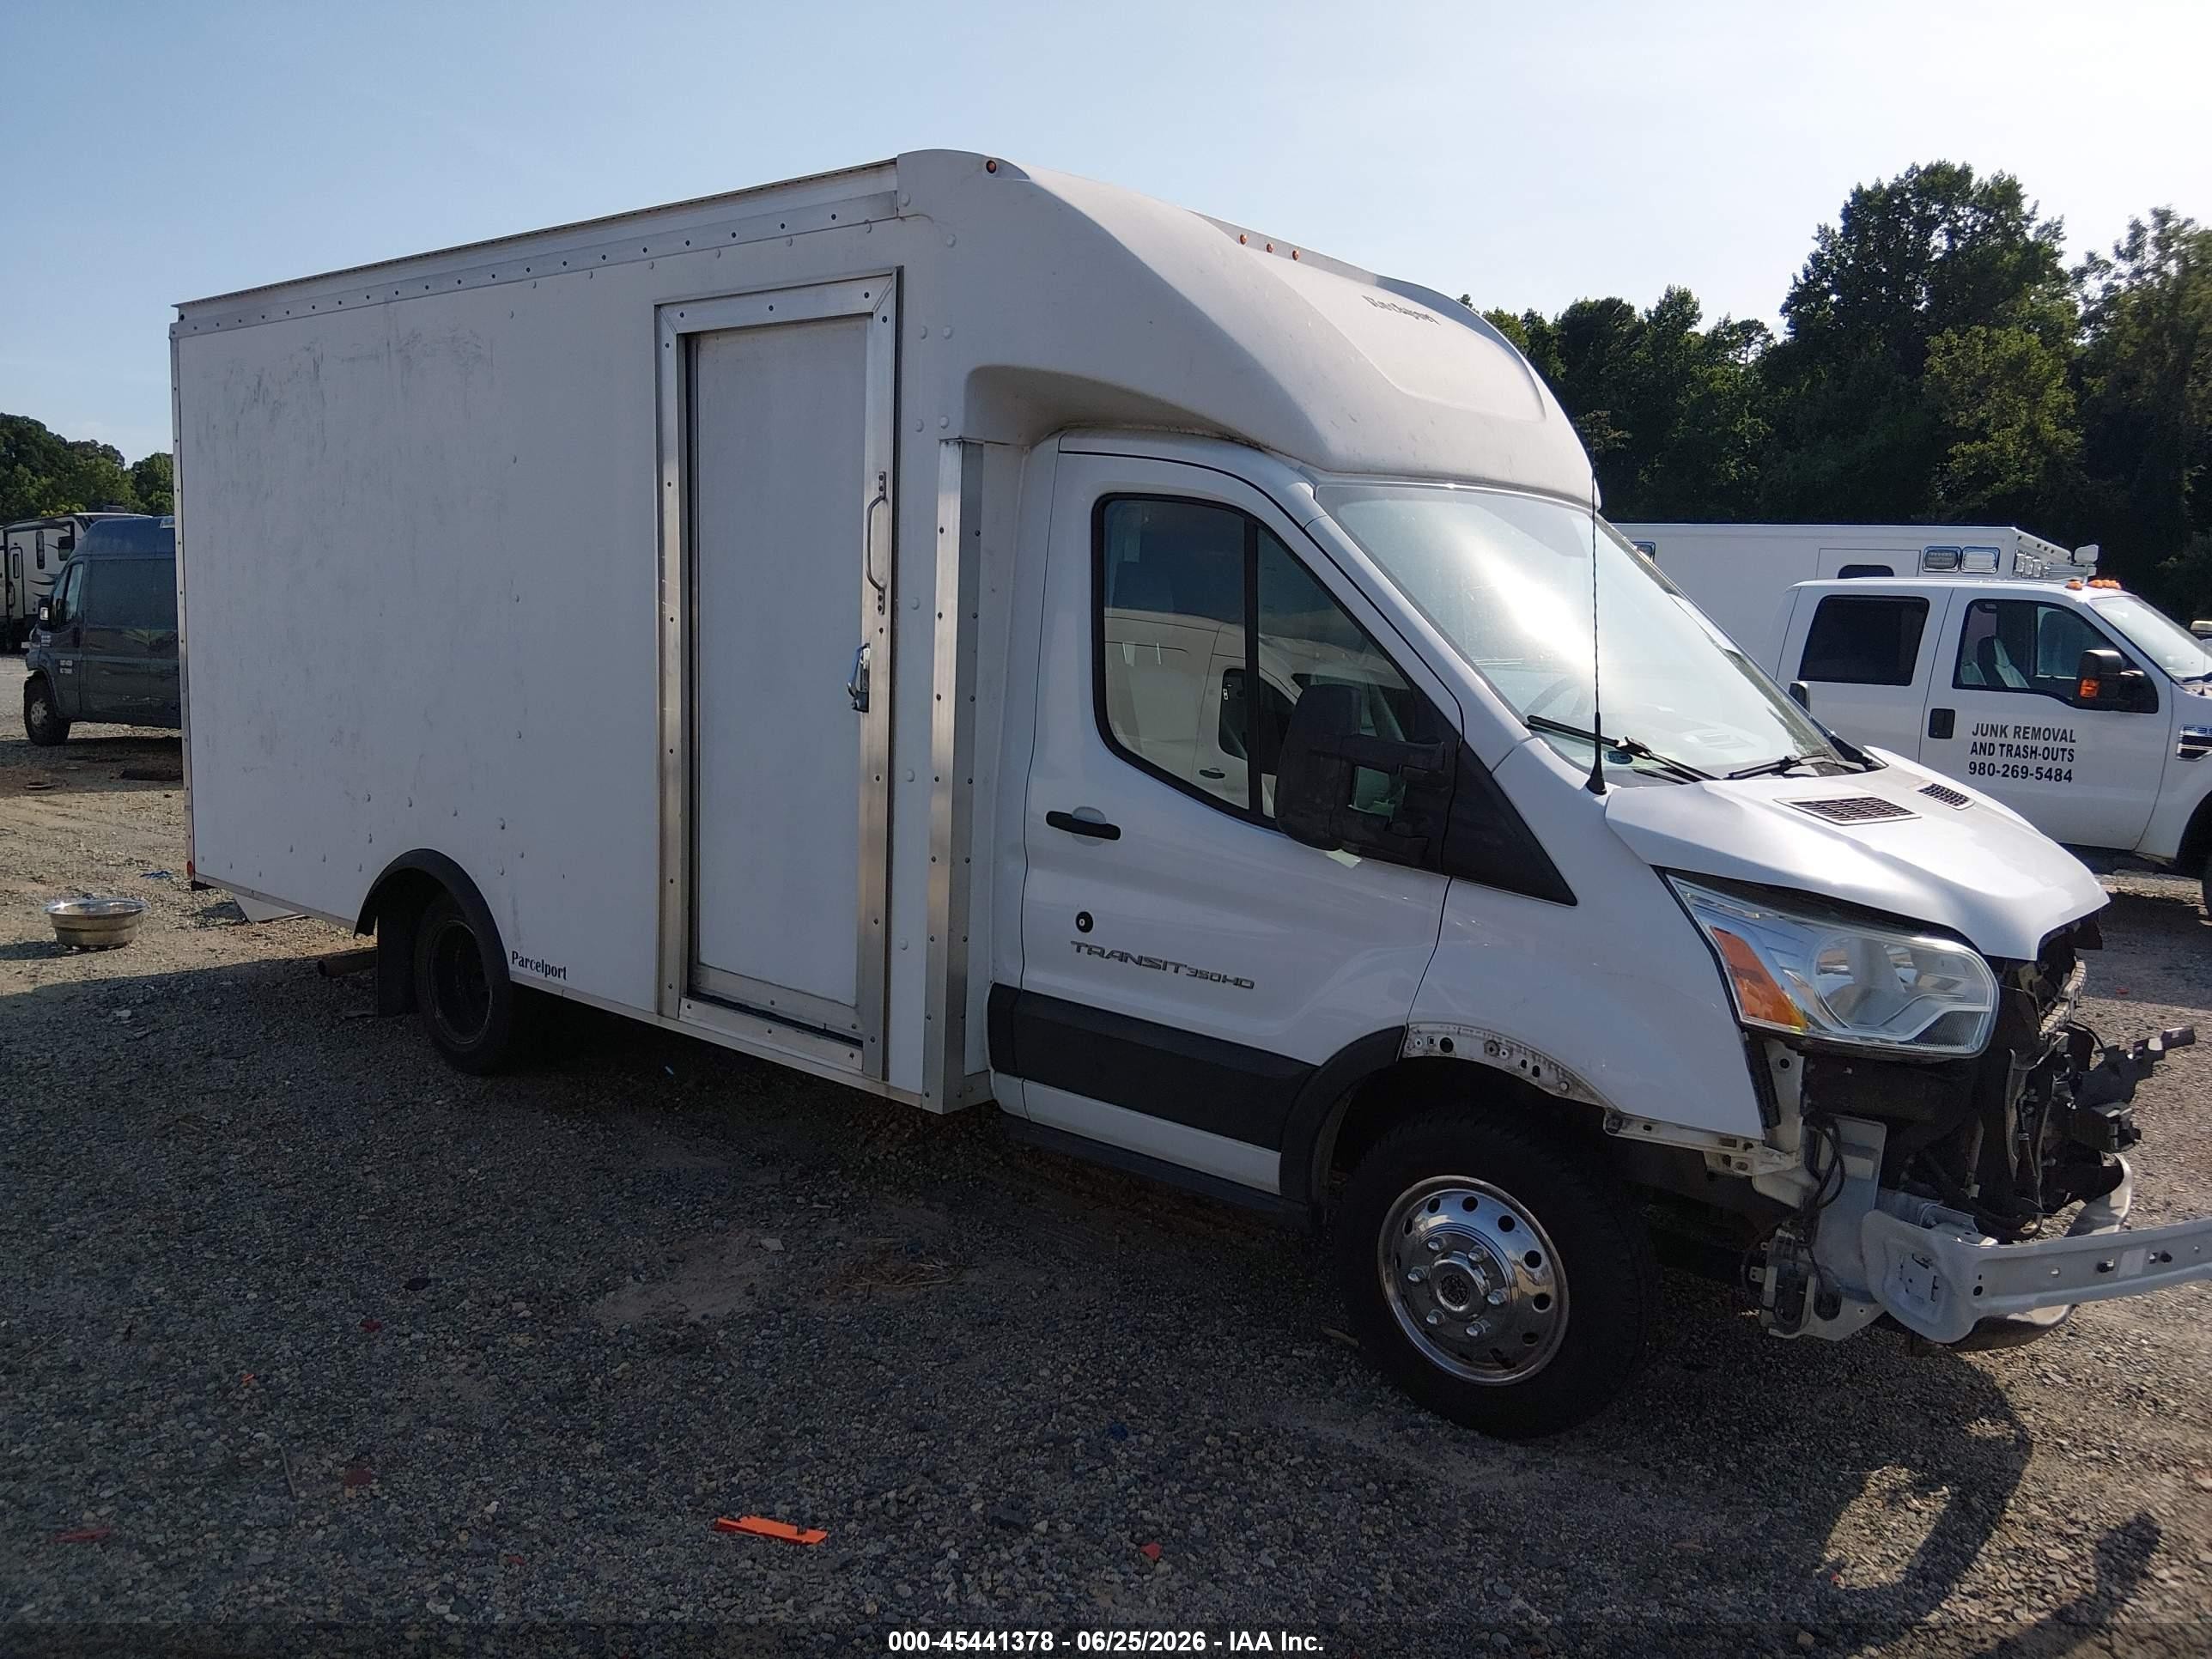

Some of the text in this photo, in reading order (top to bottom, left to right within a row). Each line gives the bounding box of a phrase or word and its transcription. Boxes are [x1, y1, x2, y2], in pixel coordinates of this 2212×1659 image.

[1972, 722, 2076, 744] JUNK REMOVAL
[1970, 741, 2075, 763] AND TRASH-OUTS
[1968, 761, 2073, 783] 980-269-5484
[512, 951, 567, 981] Parcelport
[1071, 941, 1188, 974] TRANSIT
